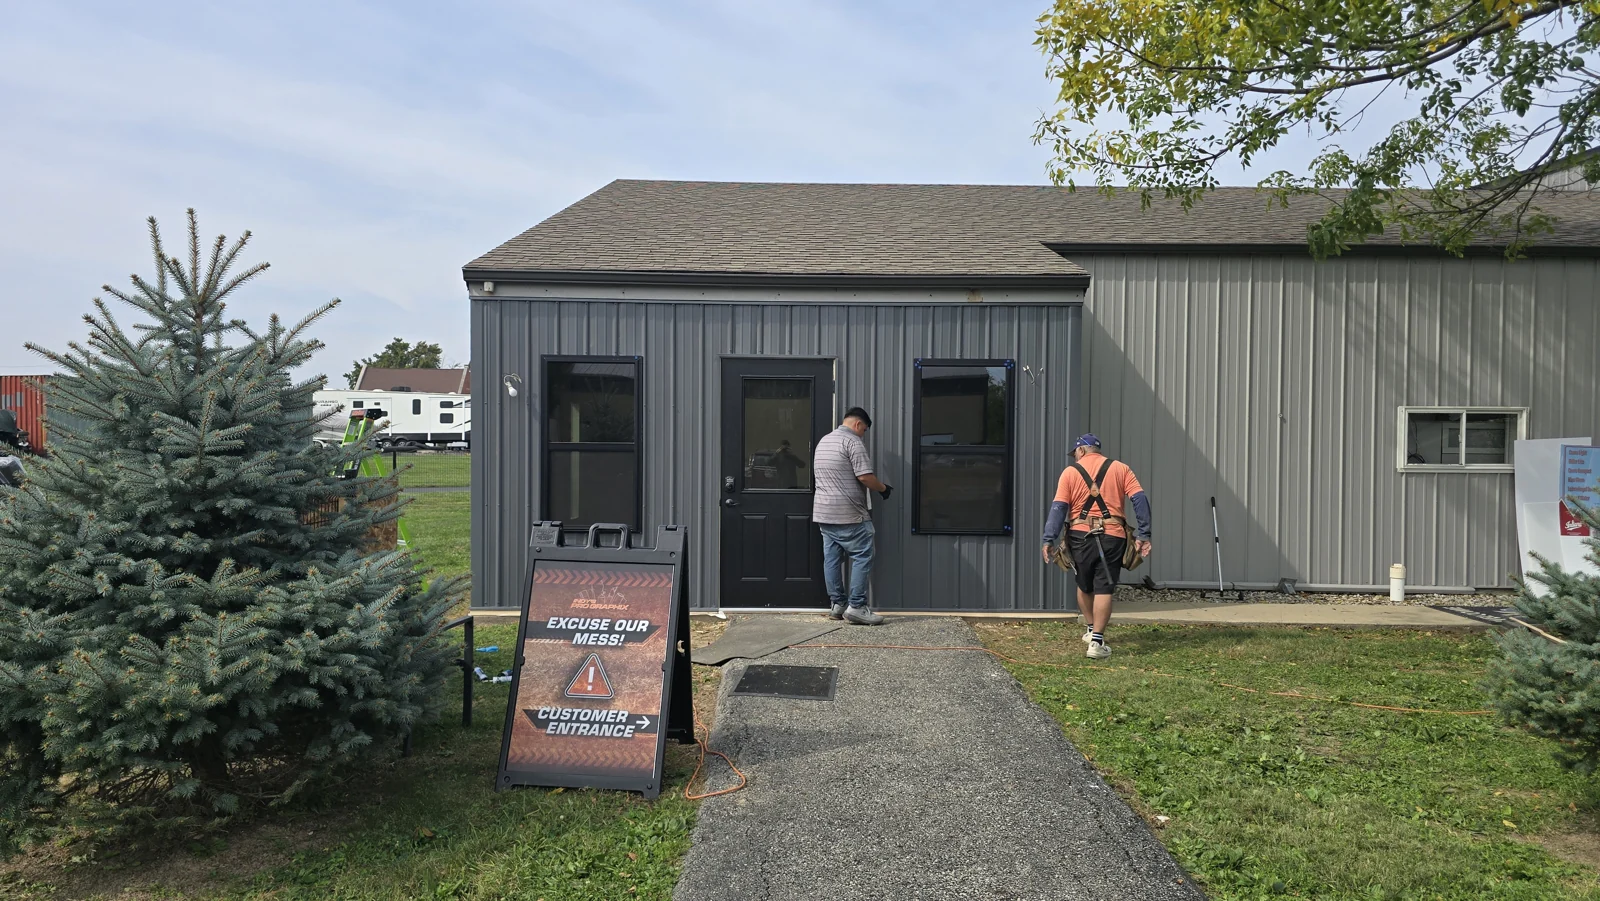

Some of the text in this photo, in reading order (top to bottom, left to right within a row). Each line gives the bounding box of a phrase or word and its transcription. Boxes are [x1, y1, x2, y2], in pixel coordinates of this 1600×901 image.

[546, 617, 649, 632] EXCUSE OUR
[572, 632, 625, 646] MESS!
[537, 707, 629, 722] CUSTOMER
[545, 722, 635, 738] ENTRANCE
